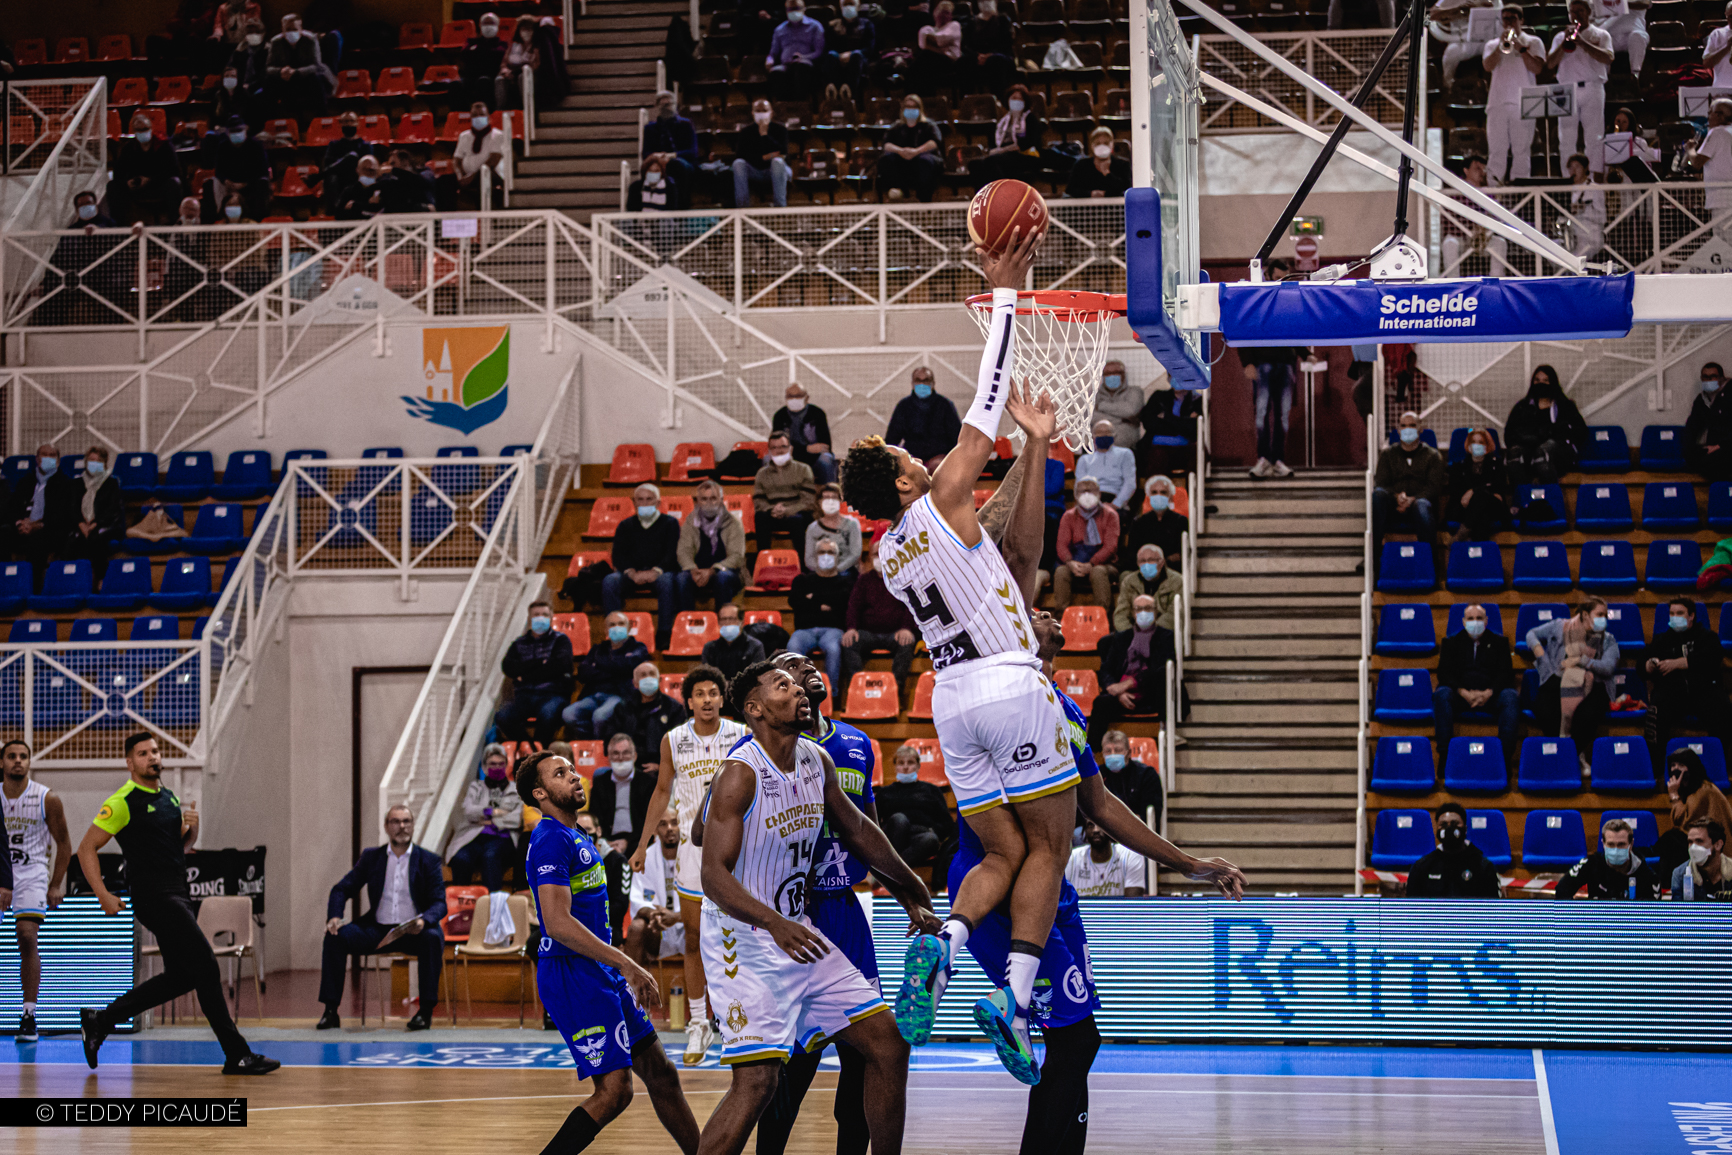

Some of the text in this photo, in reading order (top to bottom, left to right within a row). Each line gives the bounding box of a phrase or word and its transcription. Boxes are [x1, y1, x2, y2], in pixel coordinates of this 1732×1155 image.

[1380, 293, 1478, 314] Schelde
[1379, 314, 1476, 329] International
[901, 580, 958, 628] 4
[680, 759, 726, 773] CHAMPA
[688, 767, 717, 779] BASK
[1003, 757, 1050, 774] boulanger
[765, 802, 824, 829] CHAMPAGNE
[779, 817, 820, 838] BASKET
[190, 877, 225, 896] DING
[813, 876, 851, 887] 'AISNE
